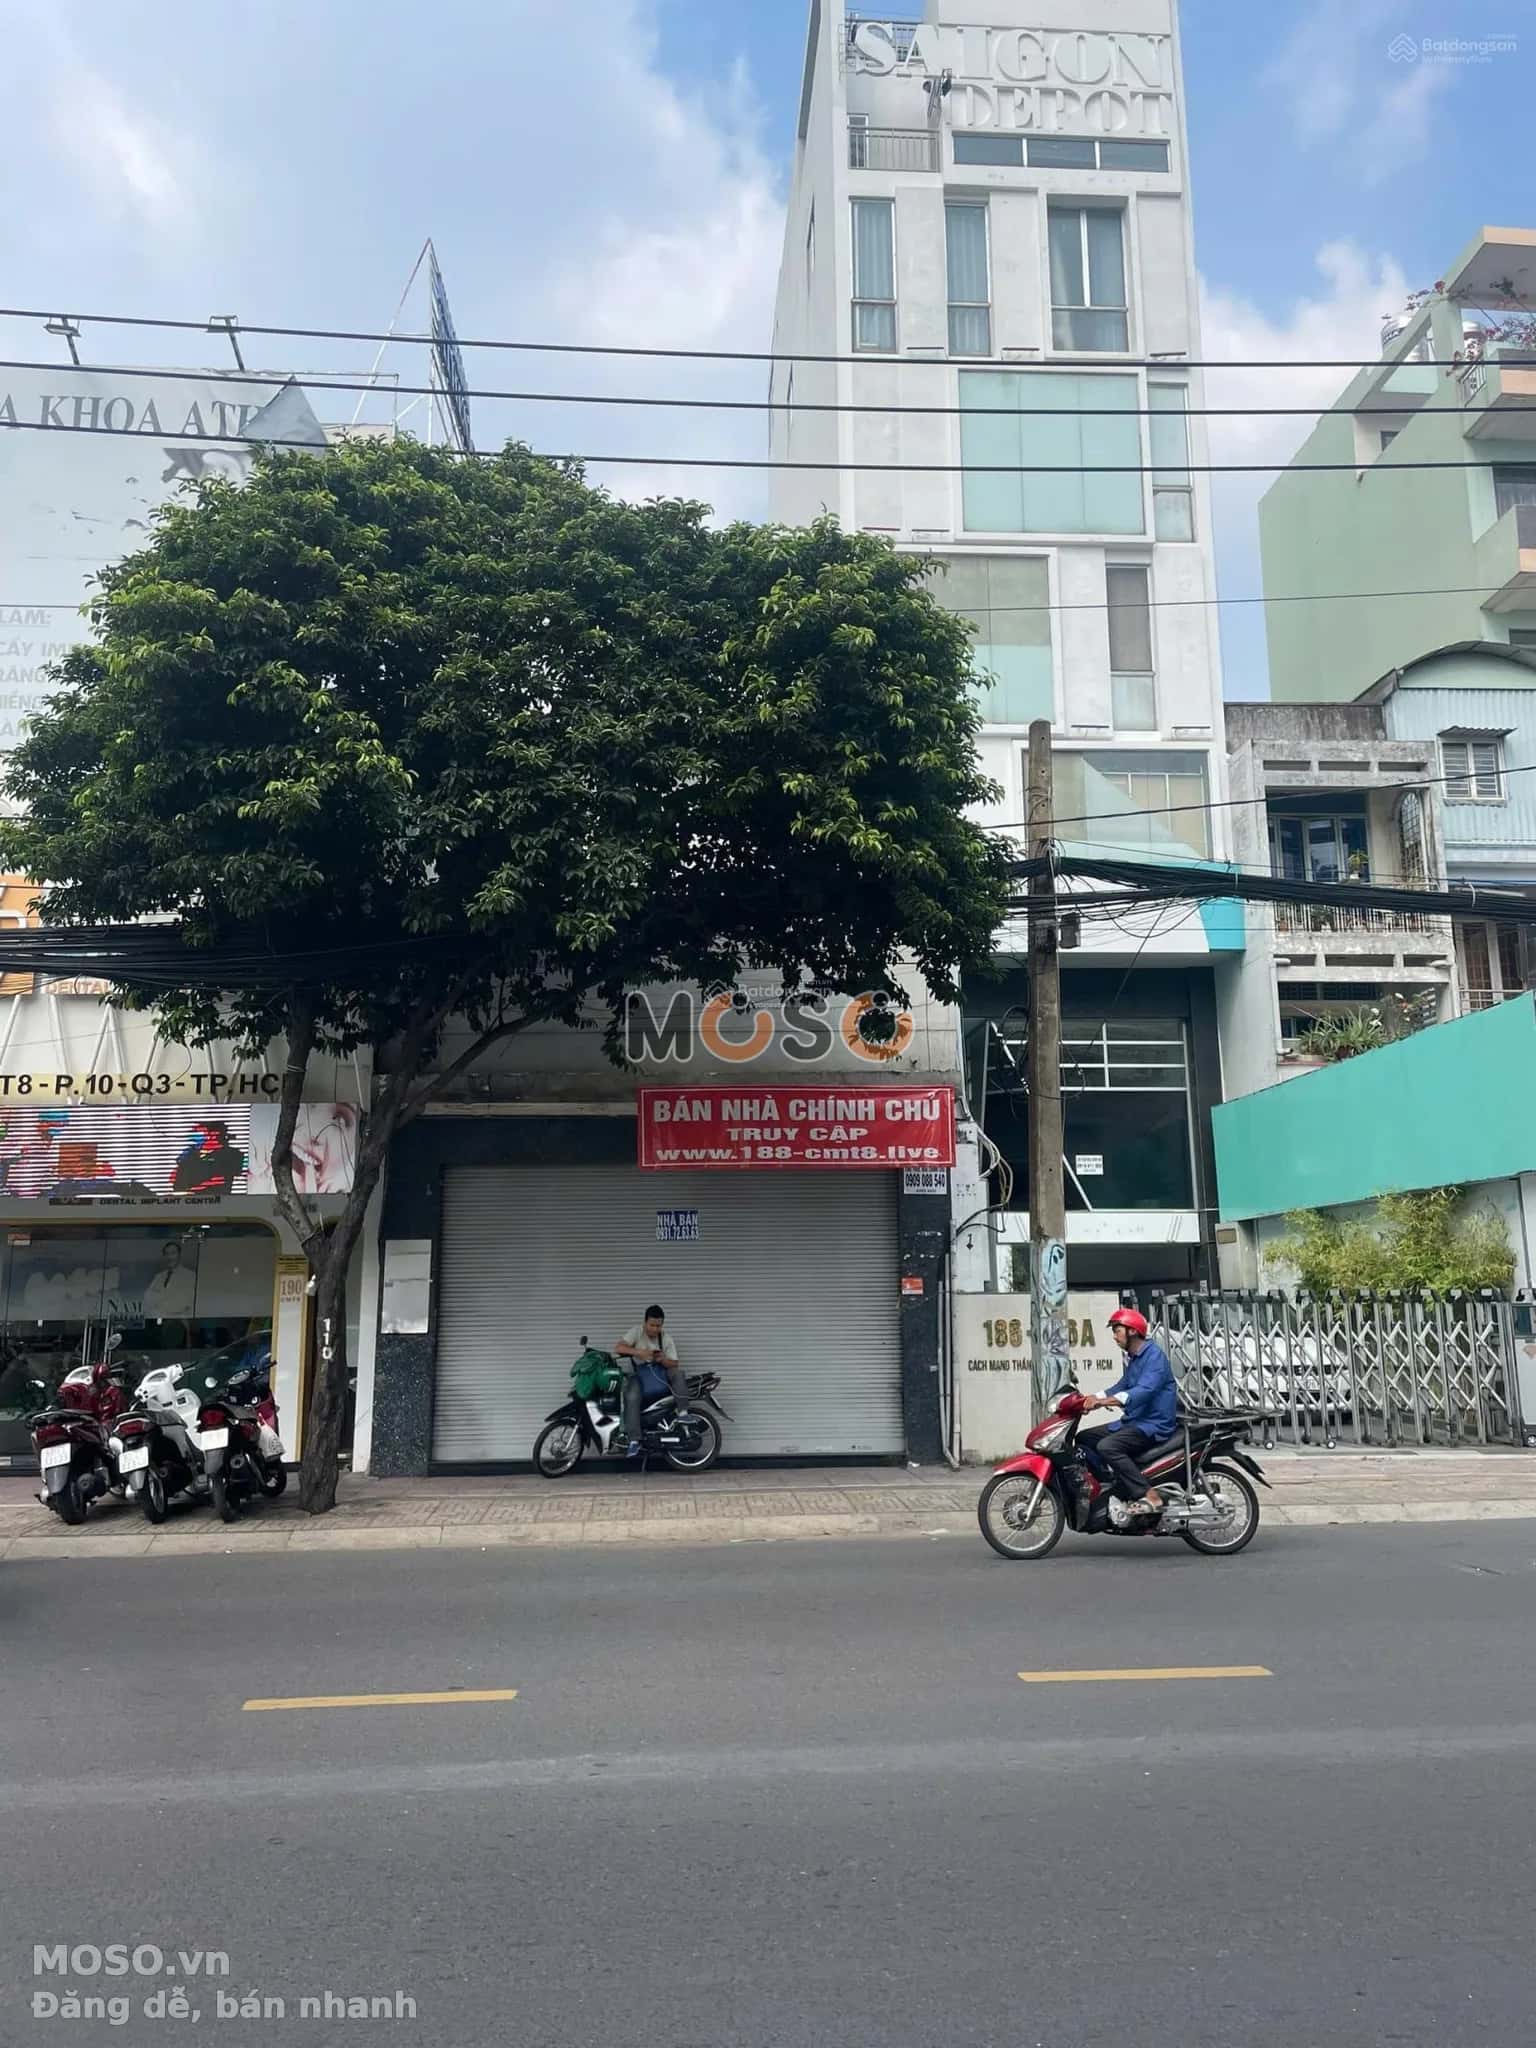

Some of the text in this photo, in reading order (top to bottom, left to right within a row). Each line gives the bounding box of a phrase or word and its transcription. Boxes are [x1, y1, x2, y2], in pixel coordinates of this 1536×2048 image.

[854, 22, 1165, 87] SAIGON
[944, 82, 1172, 134] DEPOT
[39, 394, 163, 434] KHOA
[653, 1091, 941, 1122] BÁN NHÀ CHÍNH CHỦ
[727, 1124, 868, 1143] TRUY CẬP
[656, 1145, 941, 1161] www.188-cmt8.live
